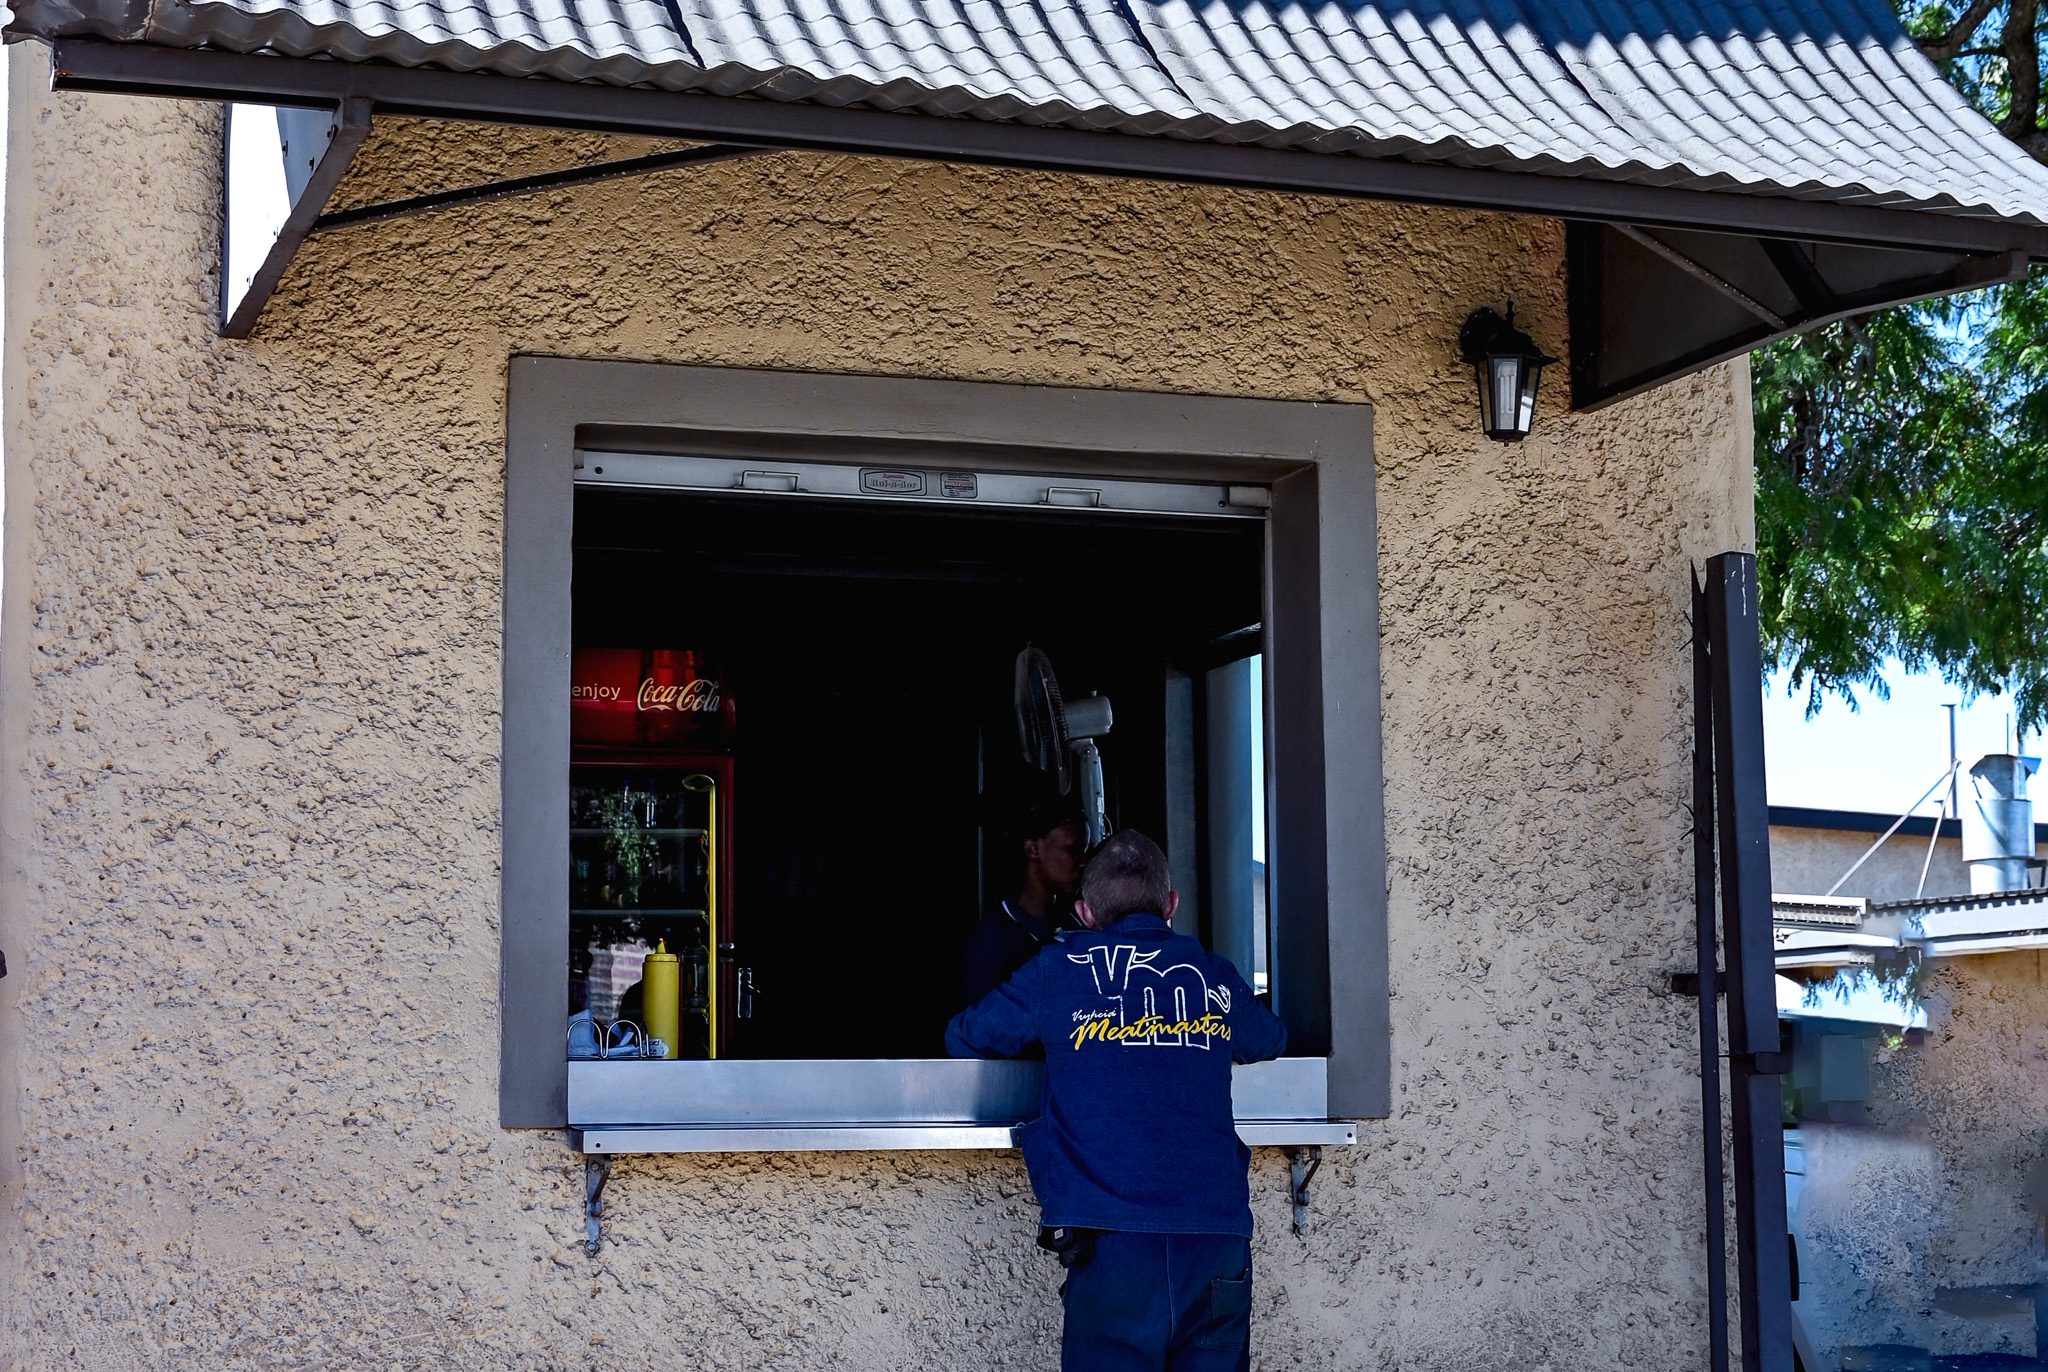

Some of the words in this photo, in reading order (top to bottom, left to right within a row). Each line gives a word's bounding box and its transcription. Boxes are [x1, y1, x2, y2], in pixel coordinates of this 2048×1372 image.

[571, 683, 621, 701] enjoy
[637, 677, 720, 712] Coca-Cola
[1070, 1013, 1231, 1050] Meatmasters
[1071, 1007, 1117, 1026] Vryheid
